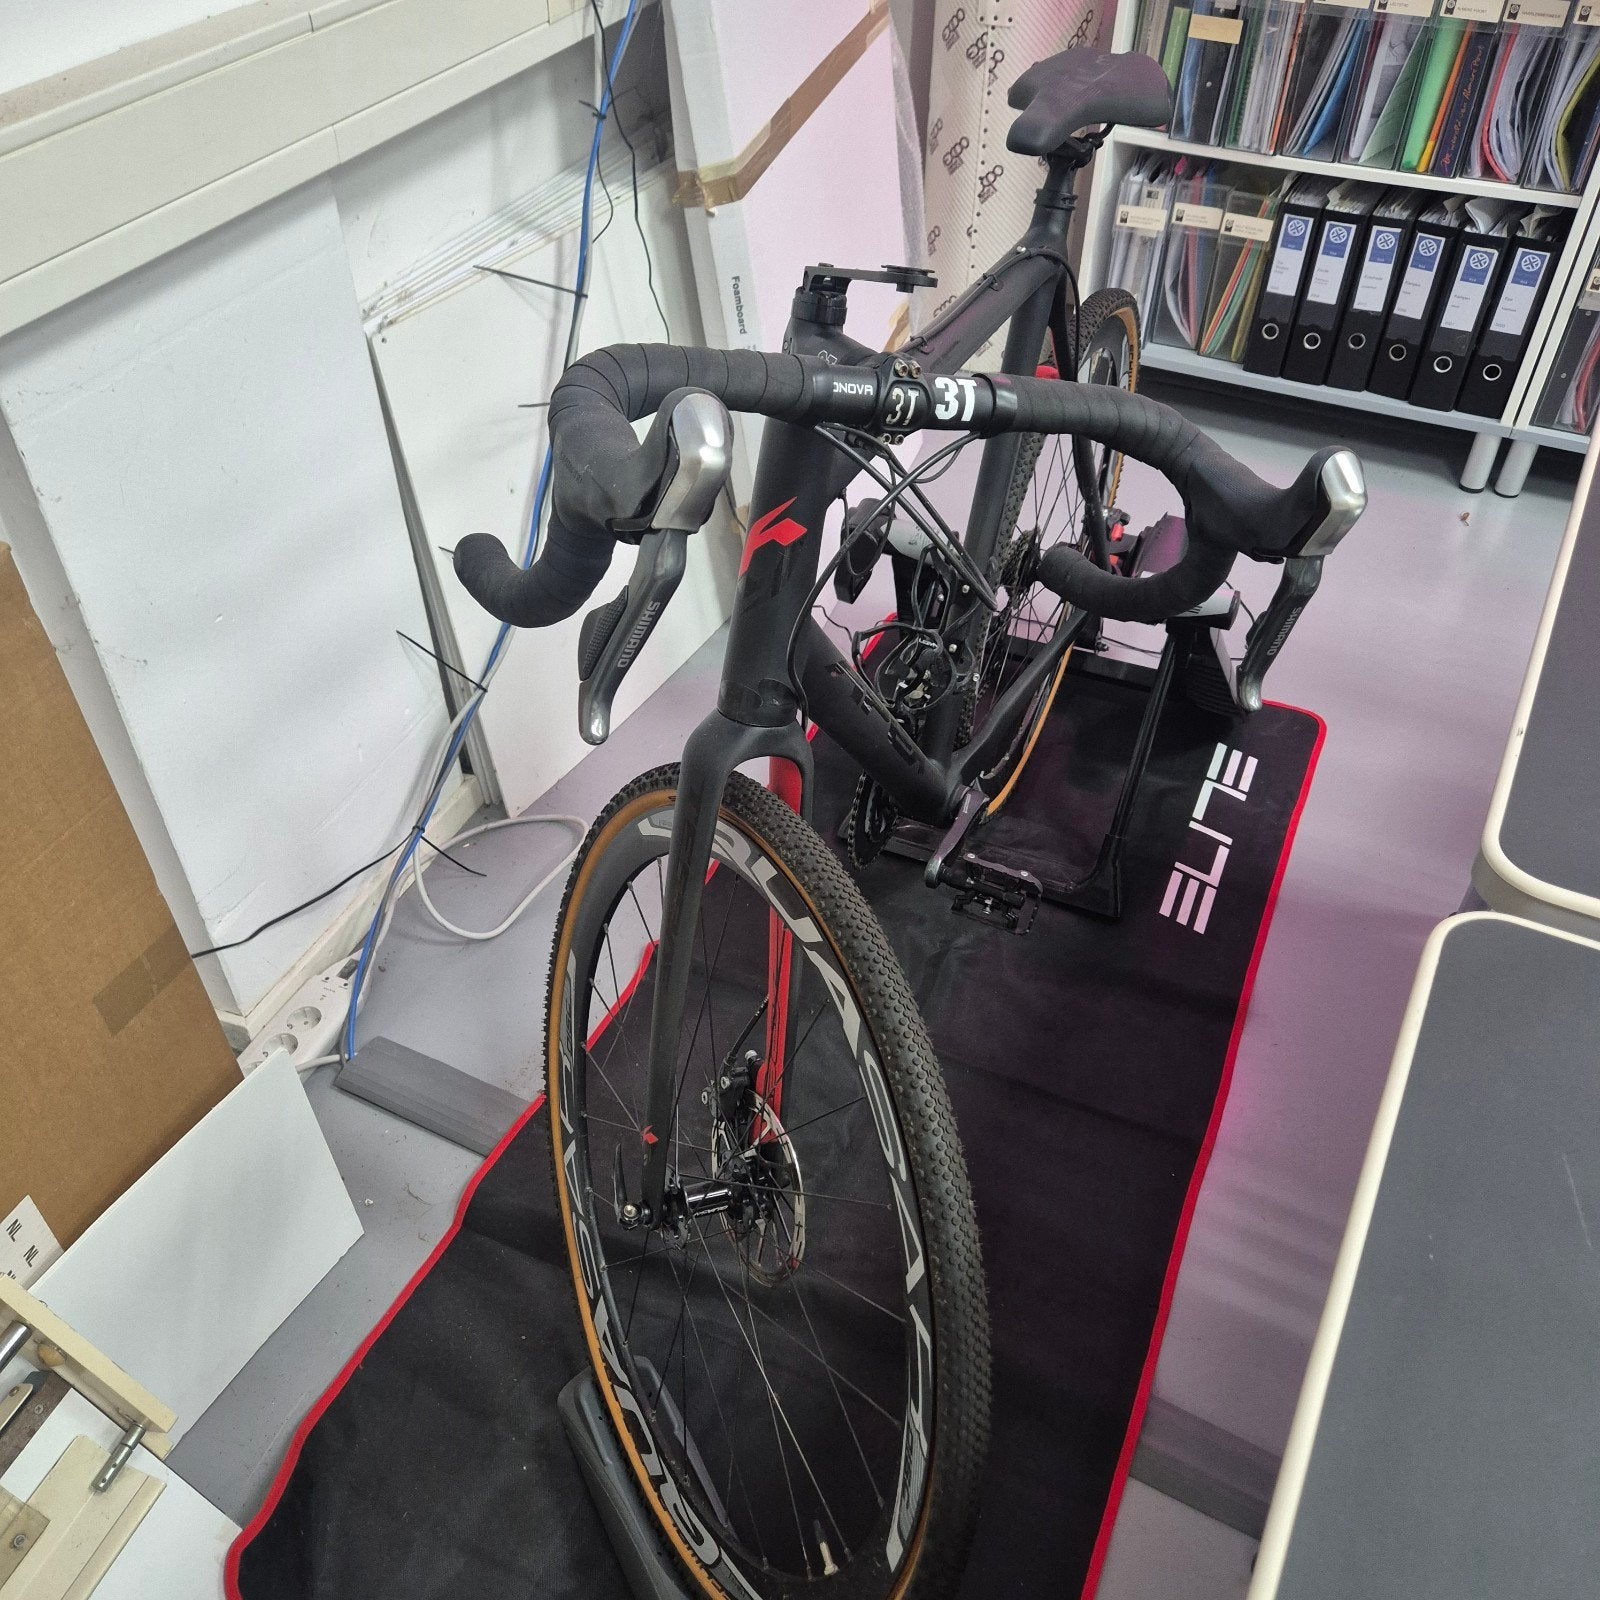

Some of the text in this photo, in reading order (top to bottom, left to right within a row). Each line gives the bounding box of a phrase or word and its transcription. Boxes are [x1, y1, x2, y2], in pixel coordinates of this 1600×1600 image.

[732, 276, 747, 334] Foamboard
[885, 387, 920, 426] 3T
[934, 376, 977, 422] 3T
[617, 600, 661, 668] SHIMANO
[1266, 606, 1303, 656] SHIMANO
[1158, 741, 1259, 935] ELITE
[6, 1218, 22, 1242] NL
[23, 1244, 39, 1268] NL
